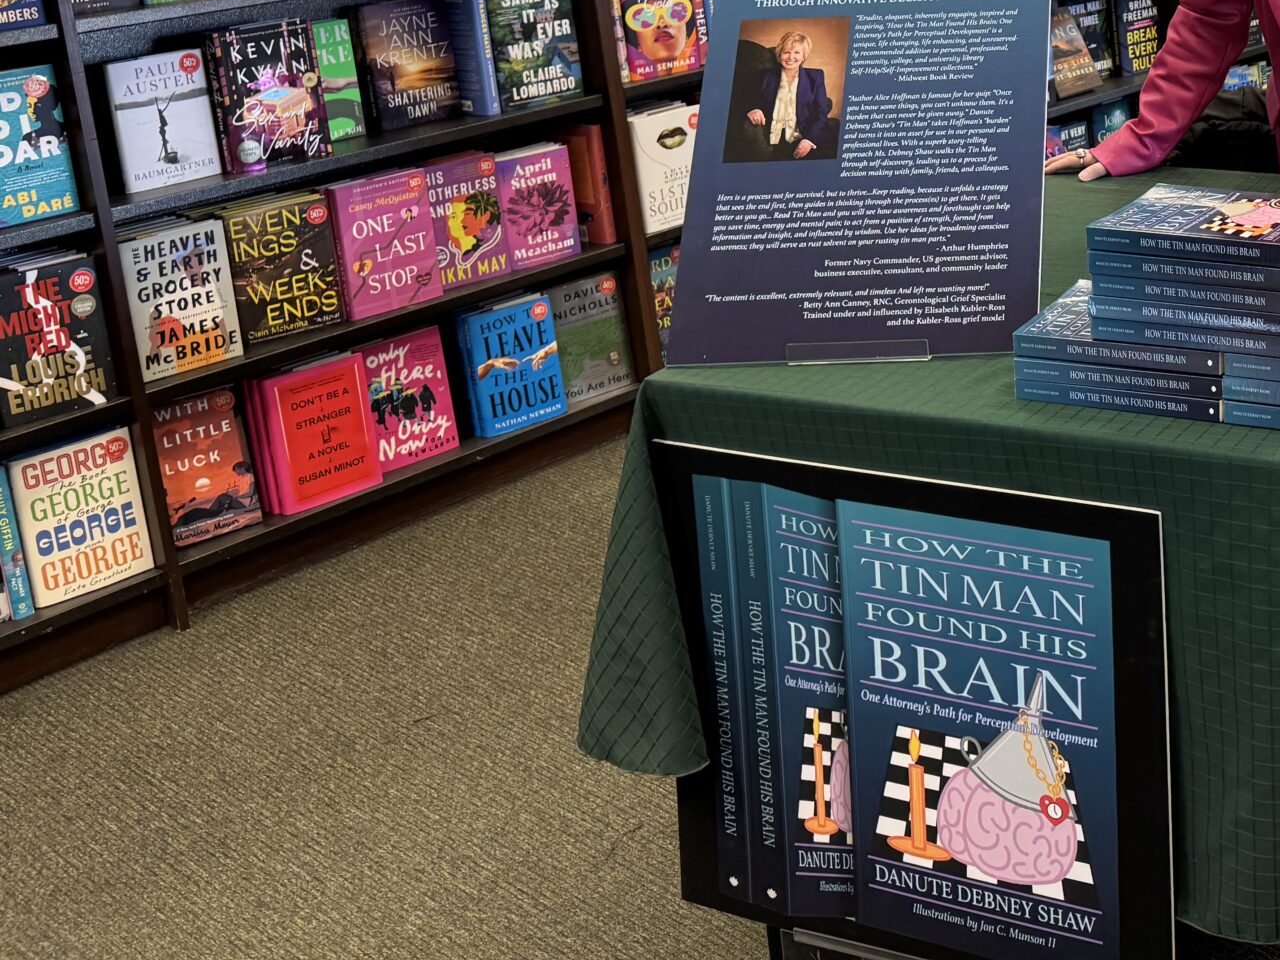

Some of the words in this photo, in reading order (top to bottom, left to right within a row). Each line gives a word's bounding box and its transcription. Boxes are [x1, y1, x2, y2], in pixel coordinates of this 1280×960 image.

[229, 34, 305, 63] KEVIN
[123, 72, 197, 97] AUSTER
[134, 62, 180, 79] PAUL
[236, 61, 307, 85] KWAN
[387, 83, 452, 108] SHATTERING
[407, 102, 438, 119] DAWN
[133, 157, 216, 182] BAUMGARTNER
[352, 212, 396, 240] ONE
[143, 229, 216, 262] HEAVEN
[374, 231, 427, 262] LAST
[1140, 238, 1158, 247] HOW
[1159, 240, 1171, 249] THE
[1172, 241, 1183, 249] TIN
[1185, 242, 1200, 251] MAN
[1202, 244, 1226, 253] FOUND
[1227, 247, 1238, 255] HIS
[1239, 248, 1260, 257] BRAIN
[136, 266, 152, 283] &
[158, 248, 218, 278] EARTH
[368, 265, 418, 294] STOP
[137, 267, 223, 304] GROCERY
[153, 289, 216, 320] STORE
[156, 315, 221, 349] JAMES
[483, 320, 549, 360] LEAVE
[145, 329, 238, 371] McBRIDE
[488, 374, 562, 419] HOUSE
[494, 413, 527, 430] NATHAN
[528, 402, 563, 421] NEWMAN
[162, 419, 233, 449] LITTLE
[163, 450, 222, 476] LUCK
[297, 466, 332, 486] SUSAN
[334, 455, 366, 473] MINOT
[30, 469, 130, 522] GEORGE
[35, 501, 137, 557] GEORGE
[40, 532, 144, 591] GEORGE
[862, 529, 975, 560] HOW
[986, 549, 1084, 579] THE
[860, 557, 950, 602] TIN
[961, 575, 1085, 626] MAN
[864, 602, 1007, 643] FOUND
[1019, 630, 1088, 659] HIS
[868, 635, 1086, 721] BRAIN
[875, 864, 953, 899] DANUTE
[957, 884, 1033, 919] DEBNEY
[1038, 905, 1096, 933] SHAW
[912, 903, 965, 926] Illustrations
[966, 916, 978, 931] by
[979, 920, 995, 933] Jon
[996, 925, 1007, 936] C.
[1009, 929, 1046, 946] Munson
[1048, 938, 1056, 948] II
